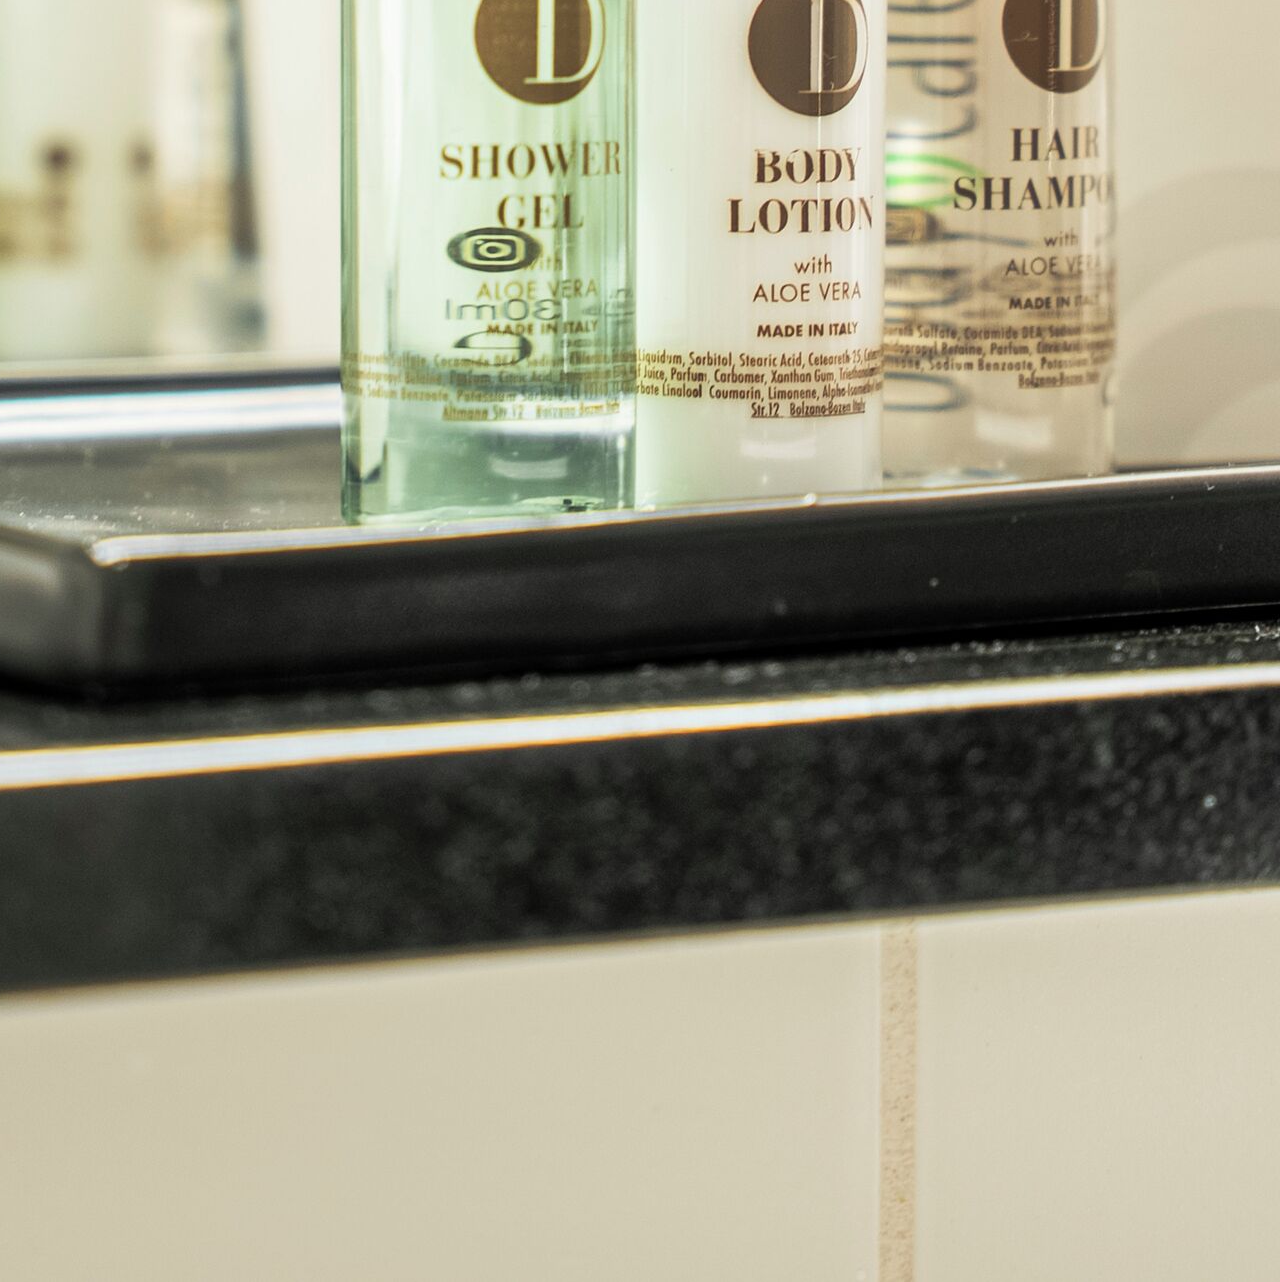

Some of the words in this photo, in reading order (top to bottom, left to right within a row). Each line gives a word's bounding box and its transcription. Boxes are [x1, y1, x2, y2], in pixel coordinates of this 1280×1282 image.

[1011, 126, 1100, 162] HAIR
[439, 141, 622, 179] SHOWER
[754, 148, 861, 184] BODY
[497, 194, 584, 229] GEL
[728, 195, 874, 235] LOTION
[1044, 228, 1079, 247] with
[794, 254, 833, 274] with
[1005, 257, 1057, 276] ALOE
[476, 280, 537, 300] ALOE
[547, 278, 599, 299] VERA
[753, 283, 810, 303] ALOE
[819, 281, 862, 301] VERA
[1009, 296, 1052, 310] MADE
[1056, 296, 1071, 309] IN
[487, 322, 534, 335] MADE
[541, 322, 558, 334] IN
[563, 320, 599, 334] ITALY
[757, 324, 803, 338] MADE
[808, 323, 824, 338] IN
[829, 321, 859, 336] ITALY
[739, 353, 778, 367] Stearic
[780, 352, 805, 369] Acid,
[714, 365, 767, 385] Carbomer,
[771, 369, 815, 384] Xanthan
[814, 368, 837, 383] Gum,
[709, 385, 764, 402] Coumarin,
[768, 386, 820, 401] Limonene,
